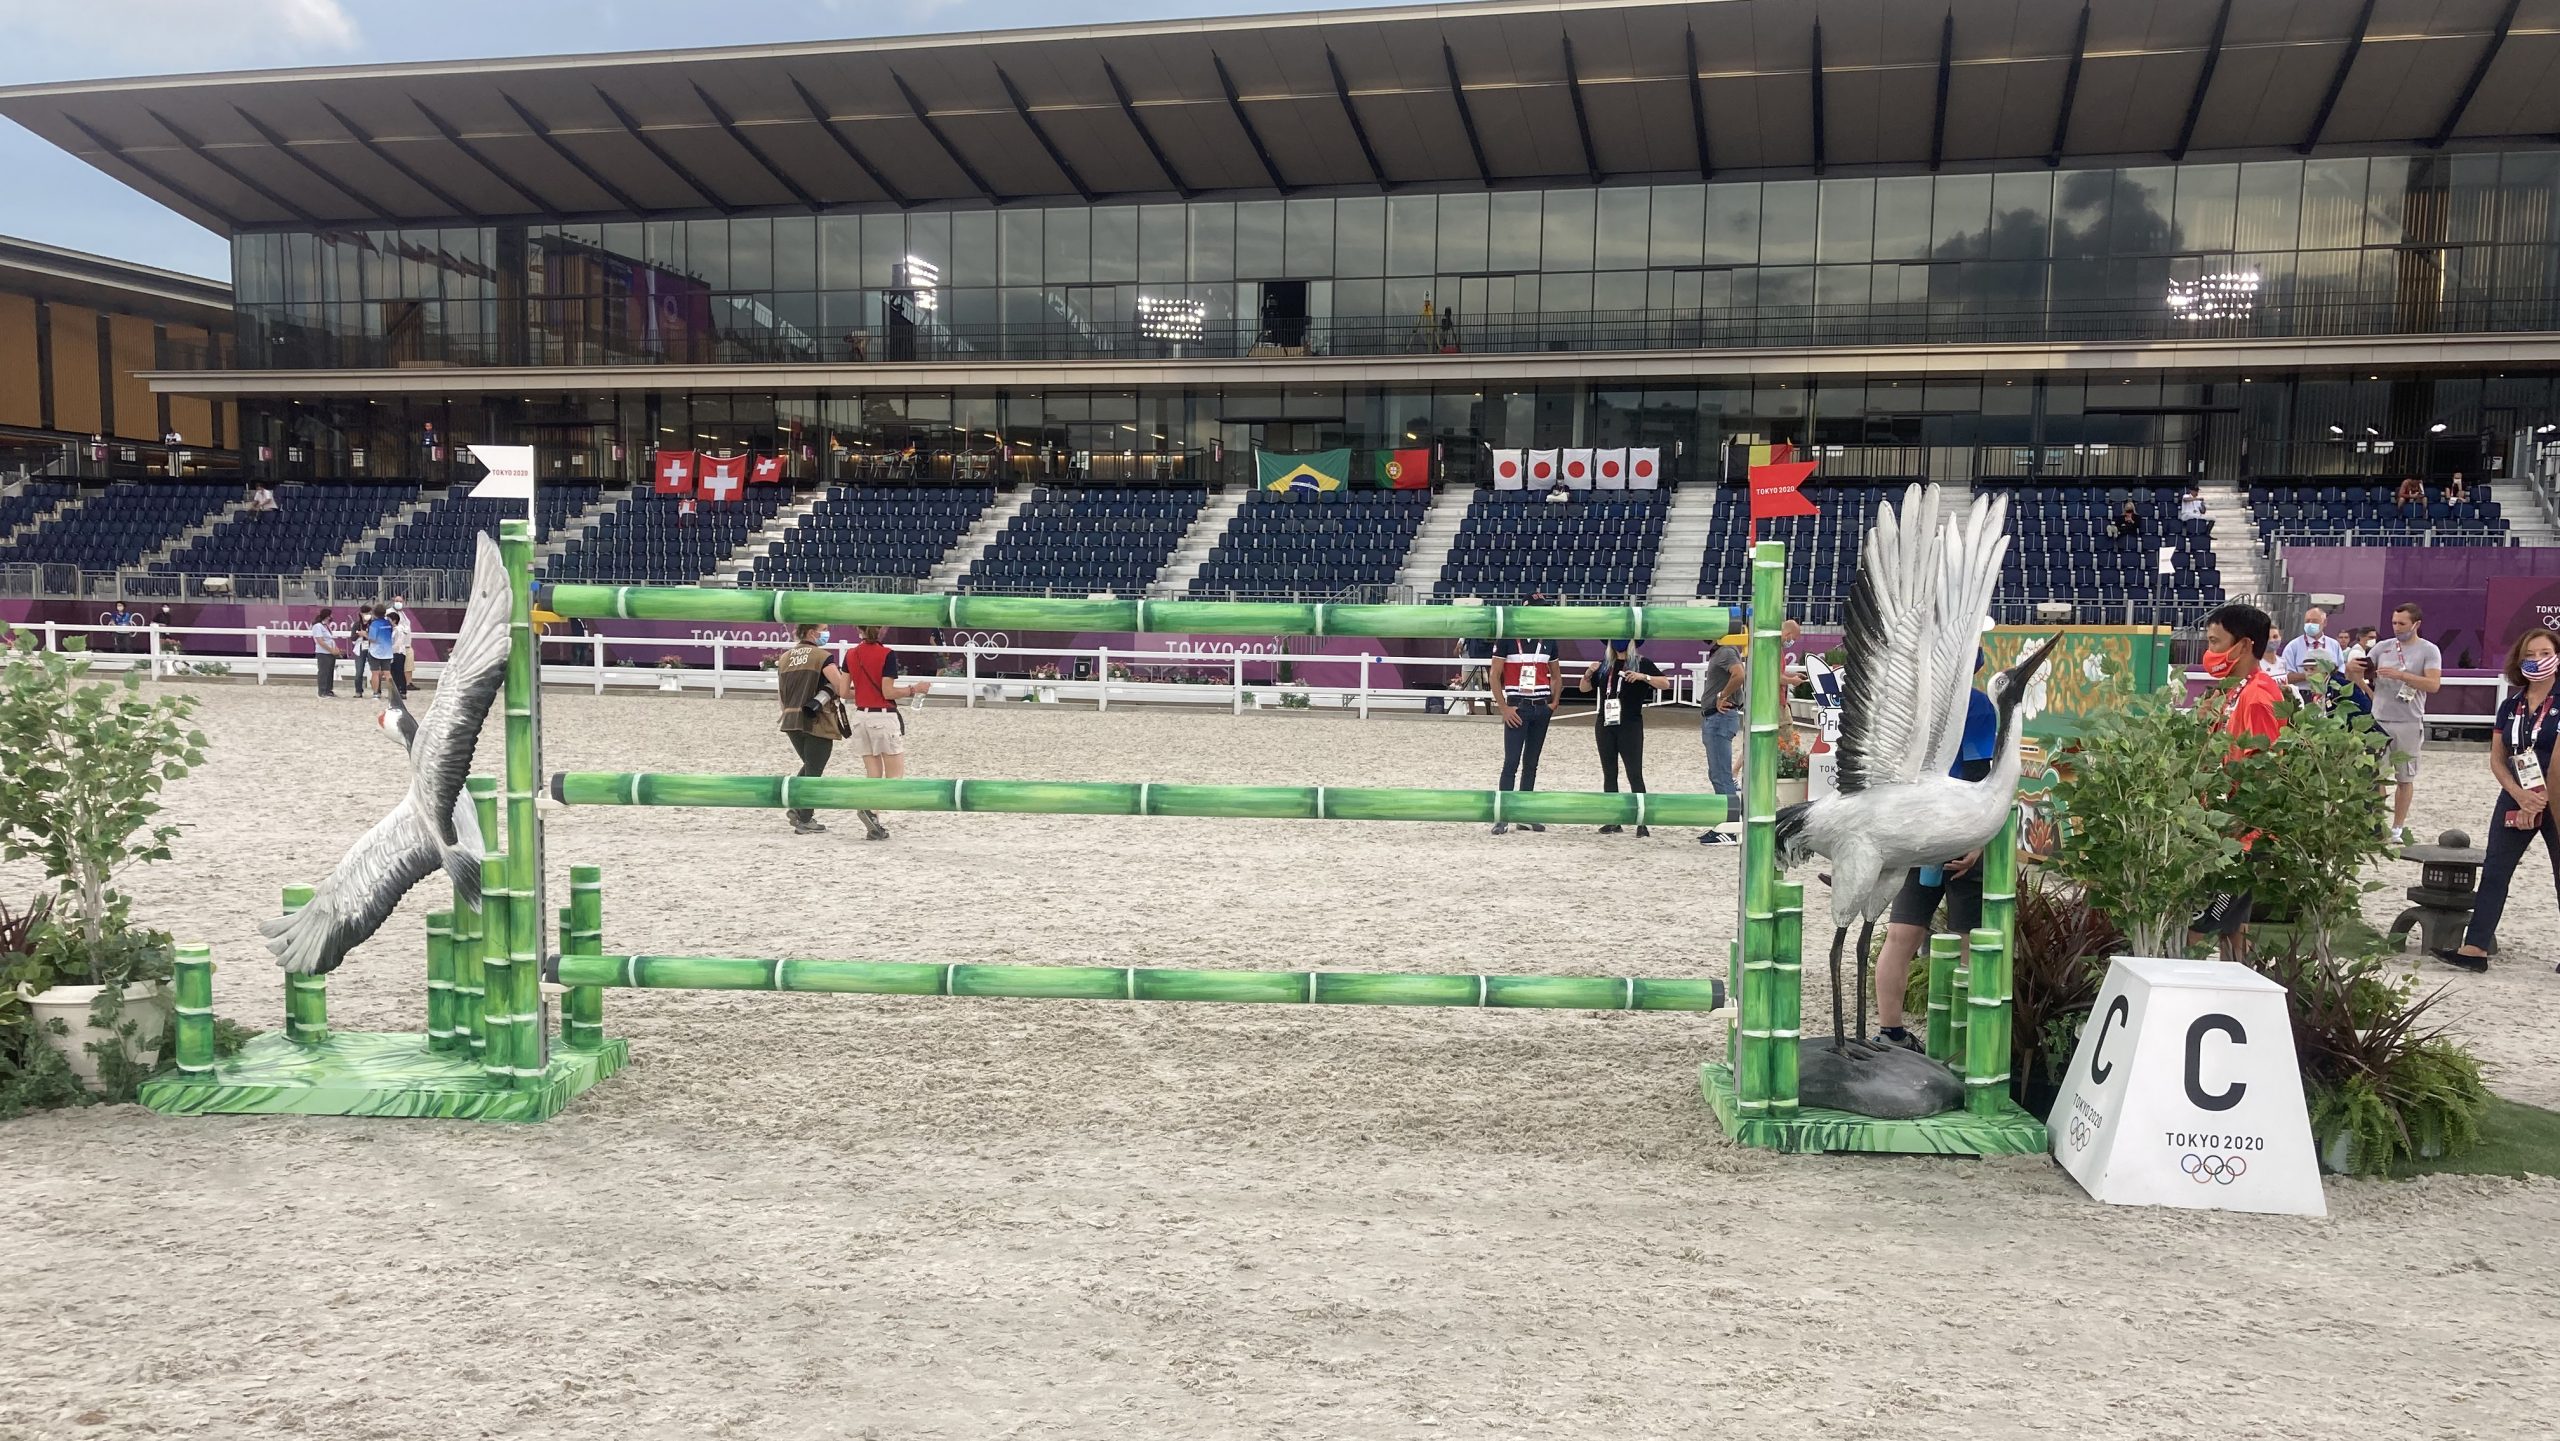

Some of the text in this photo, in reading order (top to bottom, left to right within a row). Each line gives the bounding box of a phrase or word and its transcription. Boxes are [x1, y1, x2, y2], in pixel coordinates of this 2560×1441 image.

[1756, 487, 1777, 495] TOKYO
[2535, 605, 2560, 613] TOKY
[270, 620, 313, 638] TOKY
[691, 629, 797, 650] TOKYO 202
[790, 647, 812, 656] PHOTO
[1165, 641, 1234, 662] TOKYO
[2091, 994, 2129, 1085] C
[2184, 1013, 2247, 1111] C
[2073, 1092, 2103, 1129] TOKYO 2020
[2165, 1132, 2264, 1151] TOKYO 2020
